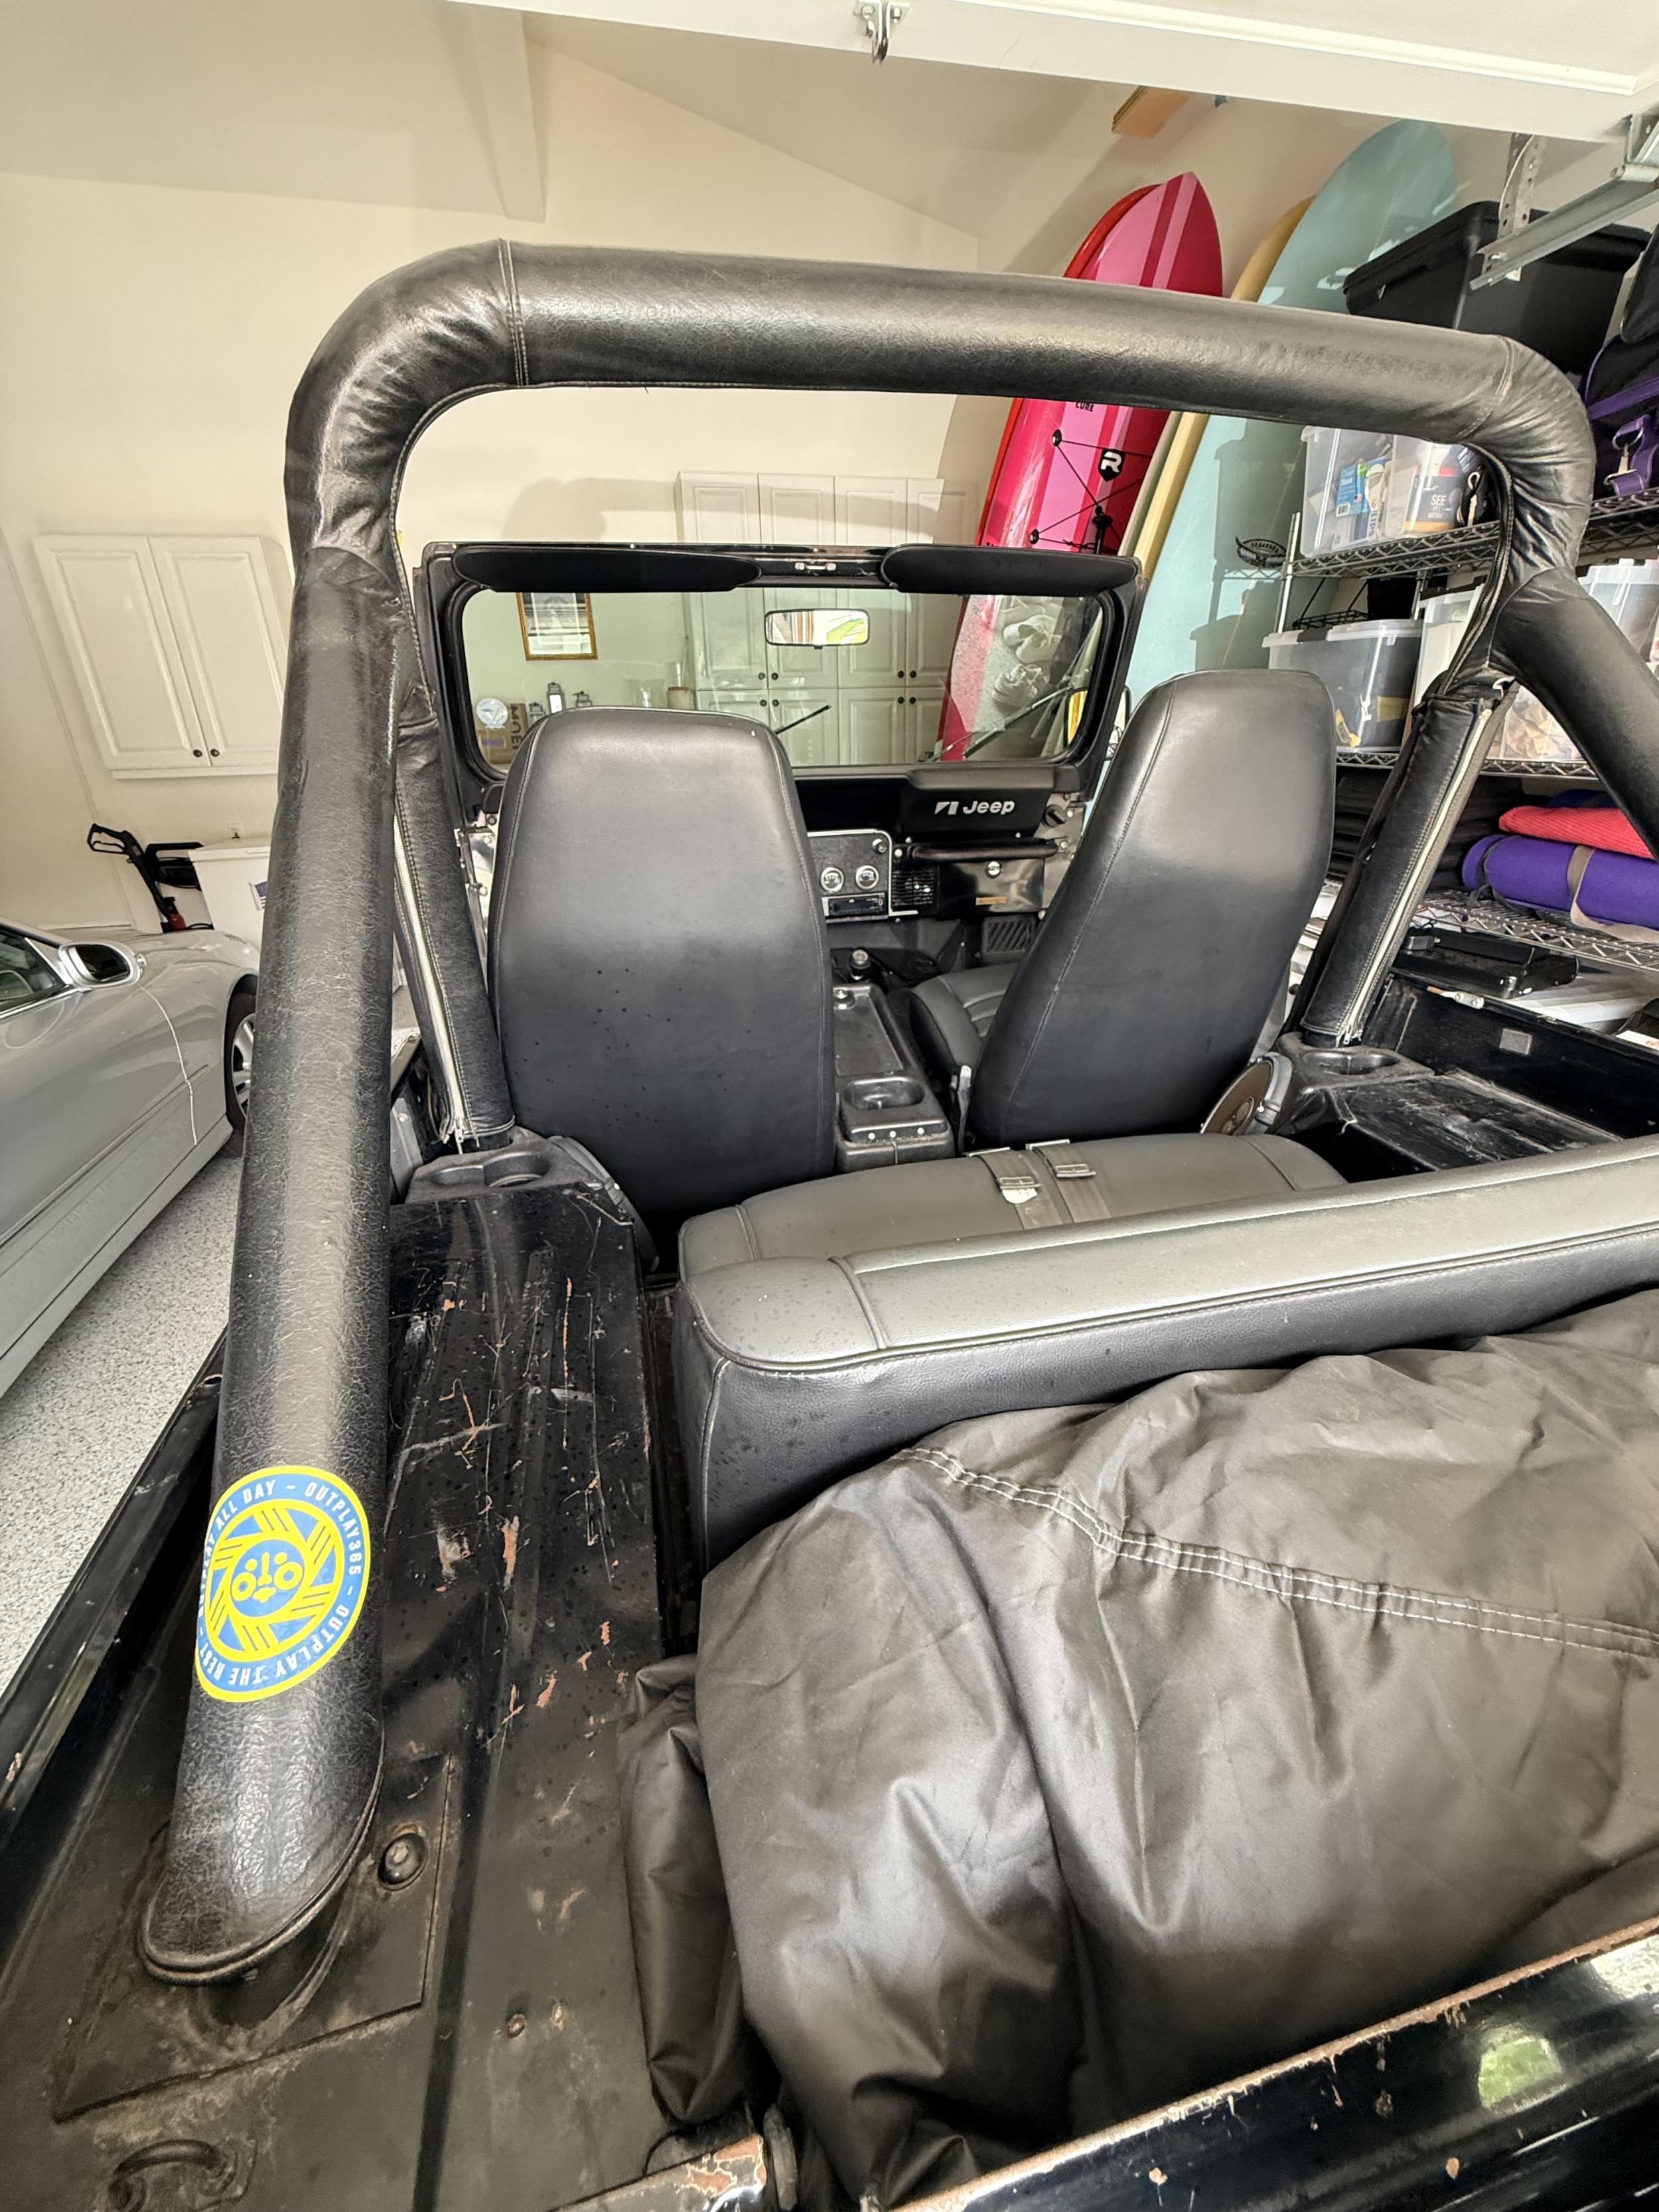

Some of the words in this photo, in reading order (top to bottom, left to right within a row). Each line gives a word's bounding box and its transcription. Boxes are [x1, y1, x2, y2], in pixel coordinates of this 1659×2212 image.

[1100, 451, 1122, 473] R
[1431, 494, 1447, 506] SEE
[962, 800, 1015, 815] Jeep
[215, 1500, 238, 1530] ALL
[243, 1479, 276, 1505] DAY
[304, 1481, 363, 1576] OUTPLAY365
[275, 1604, 350, 1678] OUTPLAY
[228, 1664, 266, 1686] THE
